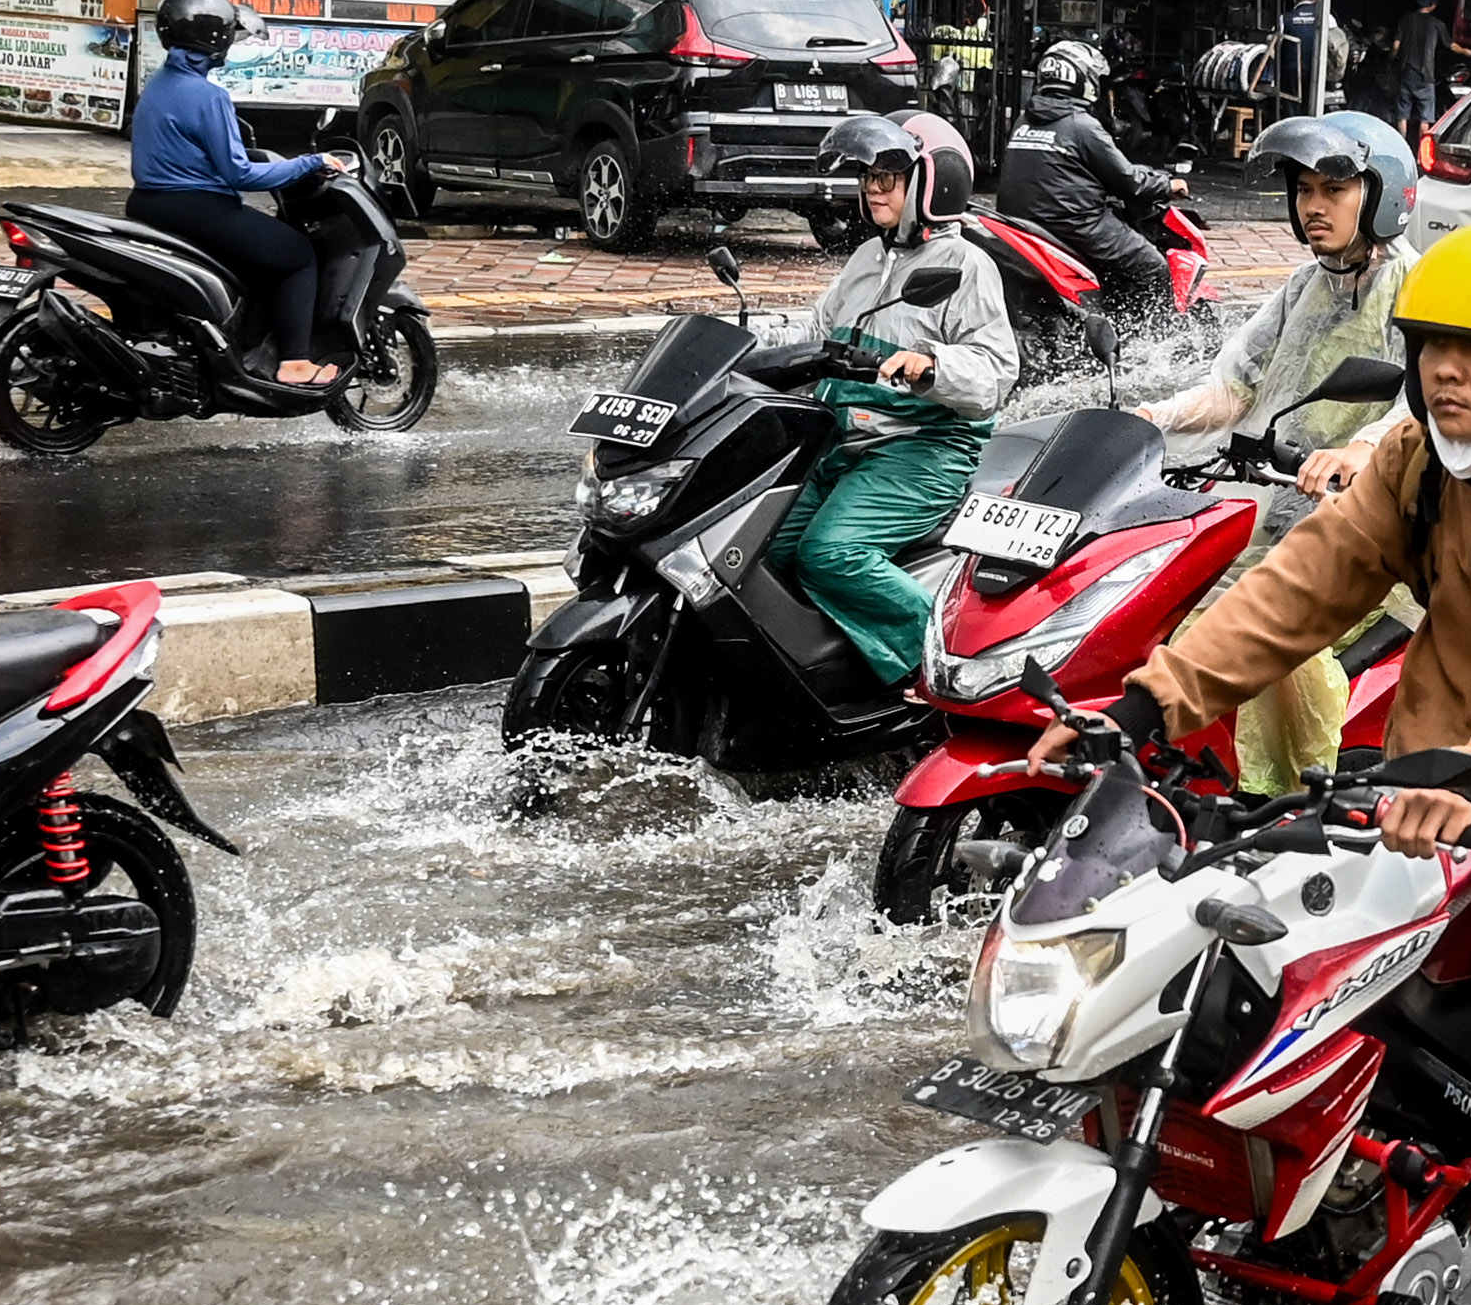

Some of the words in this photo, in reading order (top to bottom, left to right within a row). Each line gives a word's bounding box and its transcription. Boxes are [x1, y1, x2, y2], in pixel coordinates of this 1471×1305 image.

[16, 53, 56, 70] JANAR"
[778, 84, 786, 99] B
[583, 396, 601, 413] B
[597, 398, 636, 417] 4159
[636, 404, 671, 426] SCD
[963, 499, 980, 519] B
[982, 503, 1031, 529] 6681
[977, 572, 1008, 583] HONDA
[931, 1059, 963, 1082] B
[959, 1063, 1034, 1099] 3026
[1032, 1087, 1089, 1118] CVA
